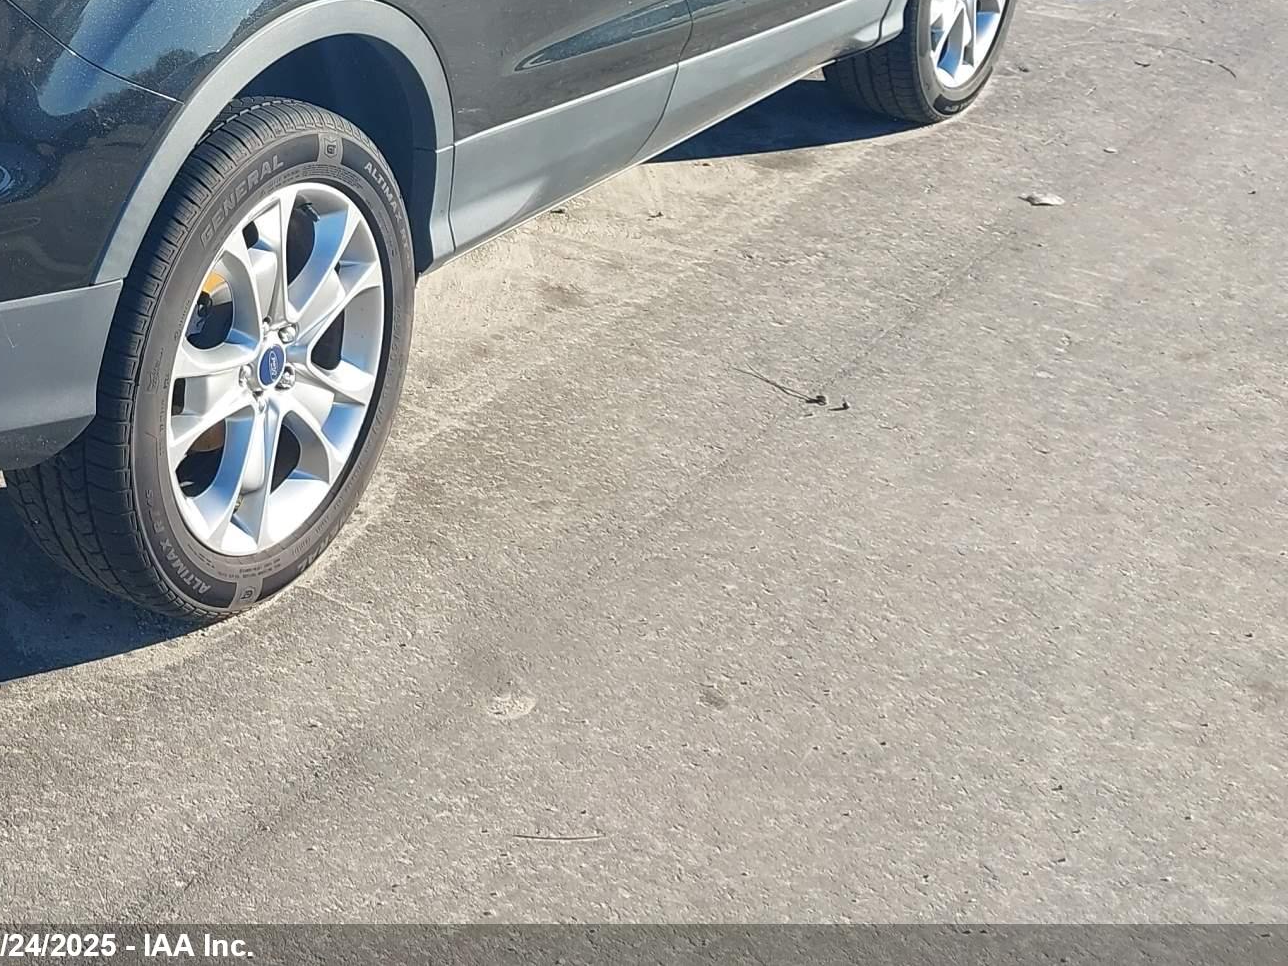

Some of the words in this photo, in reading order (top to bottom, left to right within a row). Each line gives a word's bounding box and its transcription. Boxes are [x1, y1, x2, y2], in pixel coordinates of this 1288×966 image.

[199, 154, 285, 250] GENERAL
[363, 161, 403, 224] ALTIMAX
[159, 537, 212, 595] ALTIMAX
